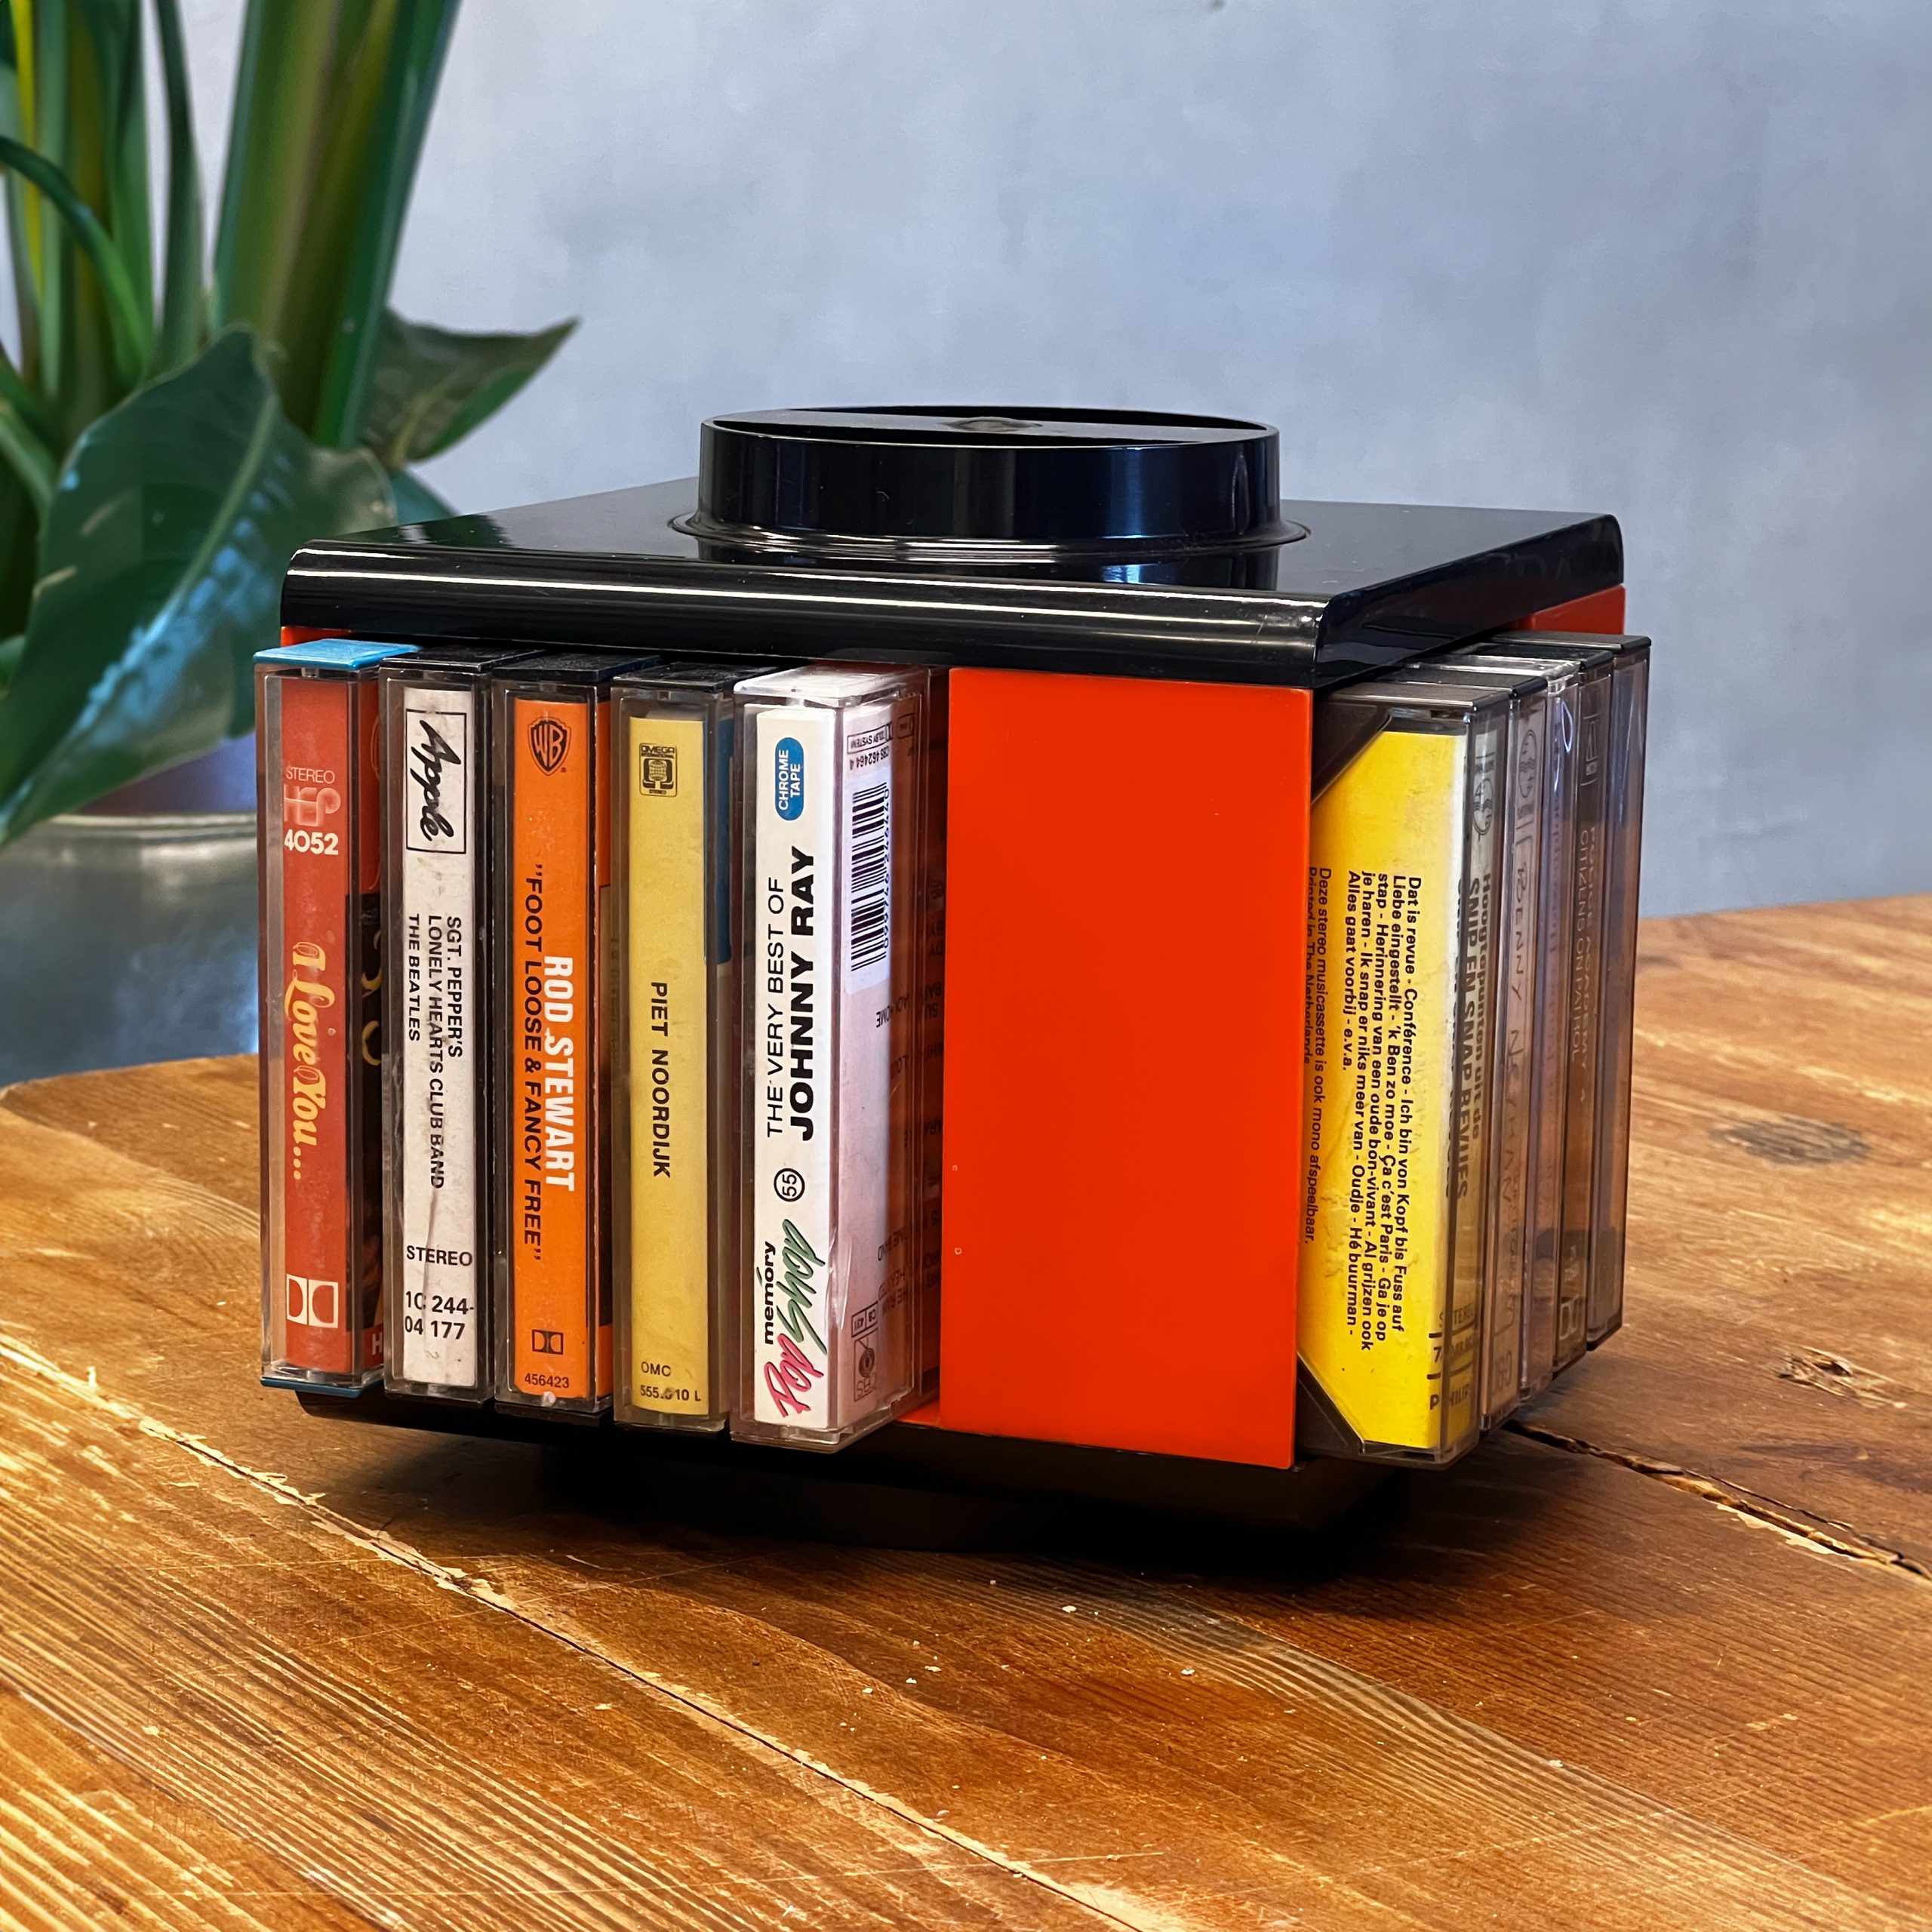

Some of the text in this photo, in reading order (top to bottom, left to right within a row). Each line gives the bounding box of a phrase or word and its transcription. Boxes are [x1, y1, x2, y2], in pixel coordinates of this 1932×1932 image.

[532, 722, 565, 768] WB
[641, 745, 675, 754] OMEGA
[286, 765, 335, 784] STEREO
[410, 719, 462, 841] Apple
[778, 749, 789, 811] CHROME
[790, 763, 801, 798] TAPE
[284, 829, 339, 856] 4052
[1347, 870, 1361, 912] Alles
[1361, 870, 1376, 886] je
[1375, 873, 1389, 909] stap
[1407, 877, 1422, 906] Dat
[1361, 891, 1375, 938] haren
[1392, 875, 1406, 919] Liebe
[1345, 916, 1356, 953] gaat
[1407, 910, 1420, 924] is
[1512, 860, 1527, 1001] BENNY
[1360, 952, 1373, 968] Ik
[1405, 928, 1416, 974] revue
[1571, 829, 1589, 1063] CITIZENS ON PATROL
[408, 913, 420, 1041] THE BEATLES
[1372, 924, 1389, 1022] Herinnering
[1389, 923, 1404, 1011] eingestellt
[447, 915, 463, 1057] SGT. PEPPER'S
[789, 845, 814, 1141] JOHNNY RAY
[1343, 957, 1357, 1015] voorbij
[1358, 971, 1369, 1011] snap
[284, 969, 335, 1065] Love
[525, 960, 542, 1051] LOOSE
[767, 876, 784, 1138] THE VERY BEST OF
[1358, 1016, 1368, 1032] er
[1472, 872, 1491, 1140] Hoogtepunten uit de
[428, 915, 445, 1189] LONELY HEARTS CLUB BAND
[1343, 1029, 1353, 1071] e.v.a.
[1357, 1036, 1371, 1070] niks
[1372, 1026, 1383, 1055] van
[1401, 988, 1418, 1084] Conférence
[525, 1057, 542, 1073] &
[543, 955, 574, 1192] ROD STEWART
[1305, 867, 1332, 1244] Deze stereo musicassette is ook mono afspeelbaar.
[1371, 1060, 1382, 1088] een
[1386, 1044, 1401, 1076] Ben
[651, 981, 671, 1179] PIET NOORDIJK
[1355, 1075, 1366, 1118] meer
[1386, 1080, 1395, 1099] zo
[292, 1065, 326, 1180] You...
[525, 1081, 542, 1171] FANCY
[1369, 1093, 1383, 1134] oude
[1384, 1104, 1395, 1140] moe
[1400, 1099, 1414, 1124] Ich
[1353, 1121, 1364, 1150] van
[1398, 1128, 1412, 1154] bin
[1365, 1139, 1382, 1227] bon-vivant
[1379, 1155, 1396, 1176] Ça
[1397, 1158, 1407, 1189] von
[781, 1173, 797, 1197] 55
[1349, 1164, 1365, 1213] Oudje
[1394, 1194, 1410, 1233] Kopf
[406, 1244, 472, 1266] STEREO
[1349, 1227, 1362, 1250] Hé
[1364, 1240, 1377, 1258] Al
[1380, 1224, 1393, 1263] Paris
[1394, 1237, 1407, 1260] bis
[1346, 1253, 1361, 1325] buurman
[1361, 1262, 1377, 1316] grijzen
[1377, 1277, 1392, 1299] Ga
[1392, 1265, 1407, 1301] Fuss
[405, 1315, 466, 1340] 04 177
[1376, 1302, 1390, 1317] je
[1392, 1304, 1404, 1332] auf
[1361, 1320, 1374, 1350] ook
[1374, 1321, 1386, 1341] op
[524, 1372, 570, 1389] 456423
[641, 1361, 672, 1377] OMC
